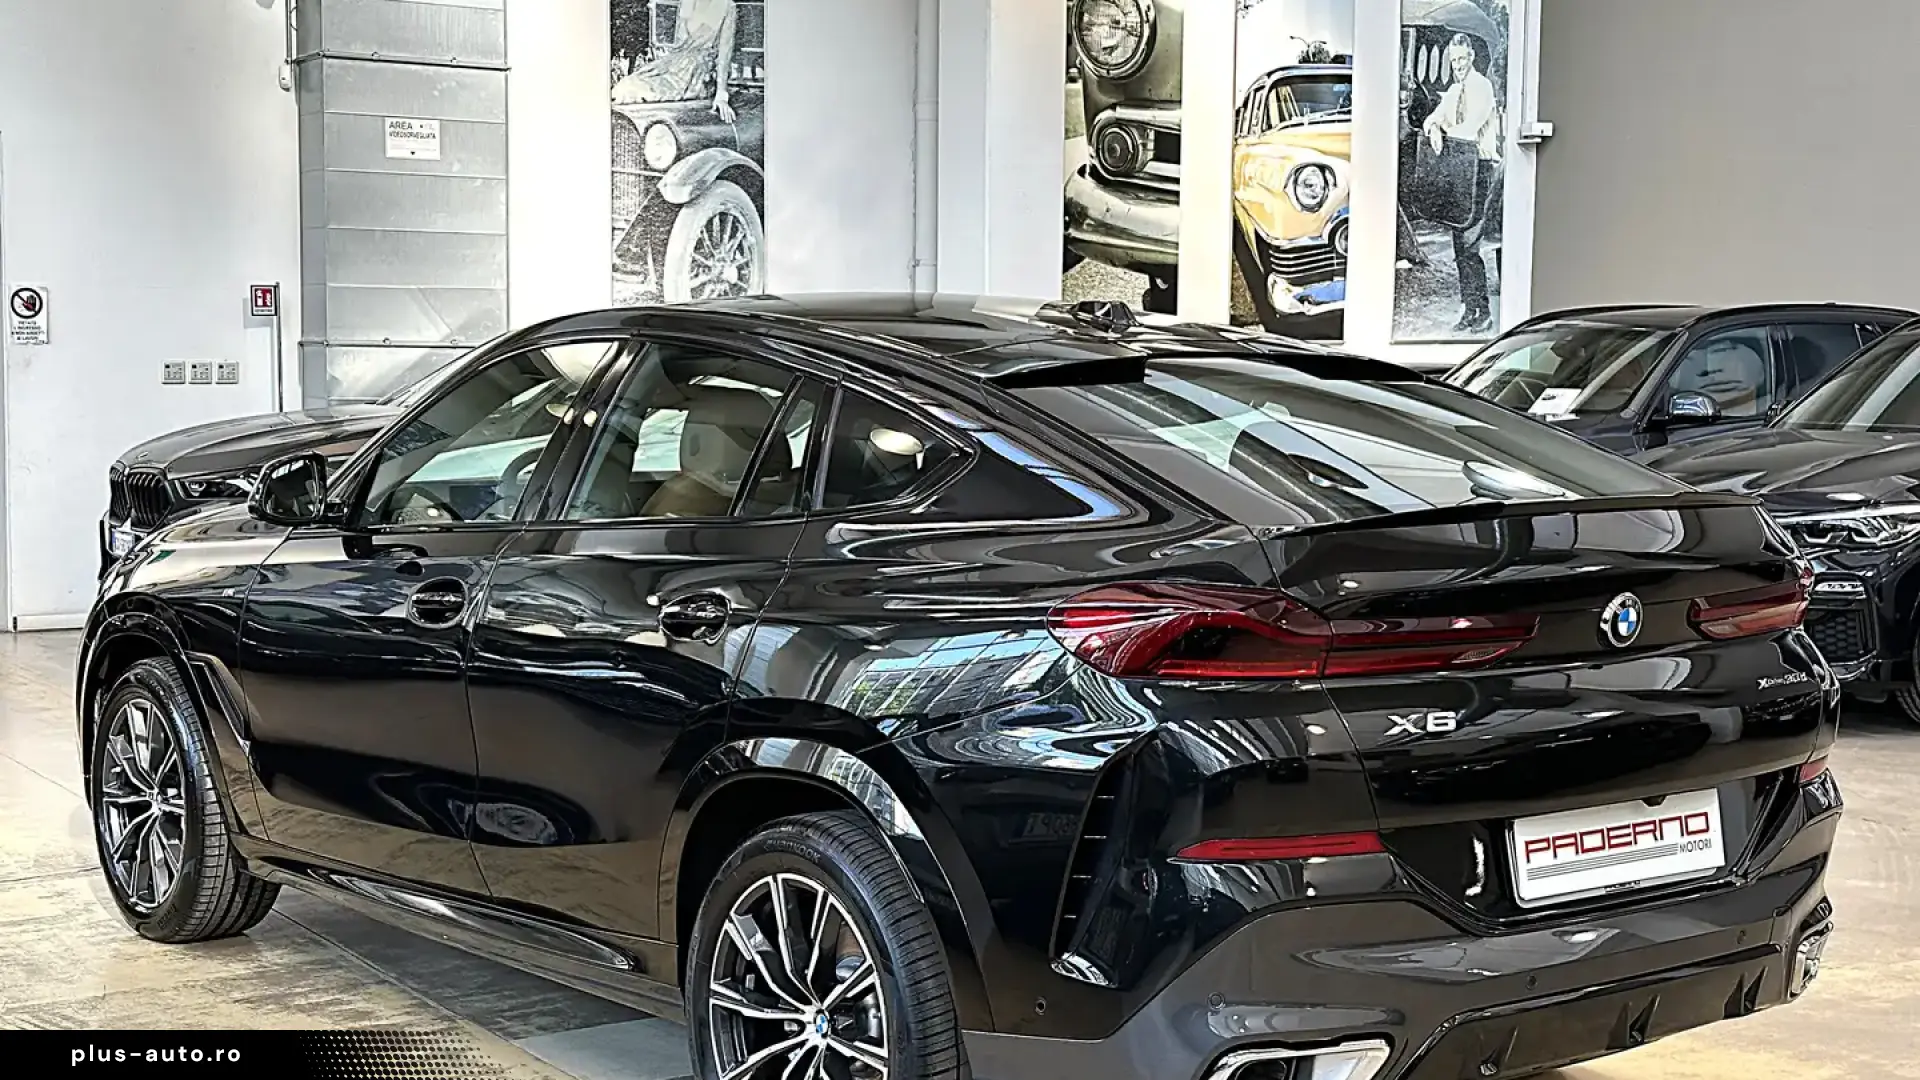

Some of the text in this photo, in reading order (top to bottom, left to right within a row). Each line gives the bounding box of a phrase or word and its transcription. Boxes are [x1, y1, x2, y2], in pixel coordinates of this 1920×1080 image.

[389, 121, 413, 129] AREA
[1383, 711, 1457, 736] X6
[1524, 811, 1710, 864] PADERNO
[1679, 838, 1714, 854] MOTORI
